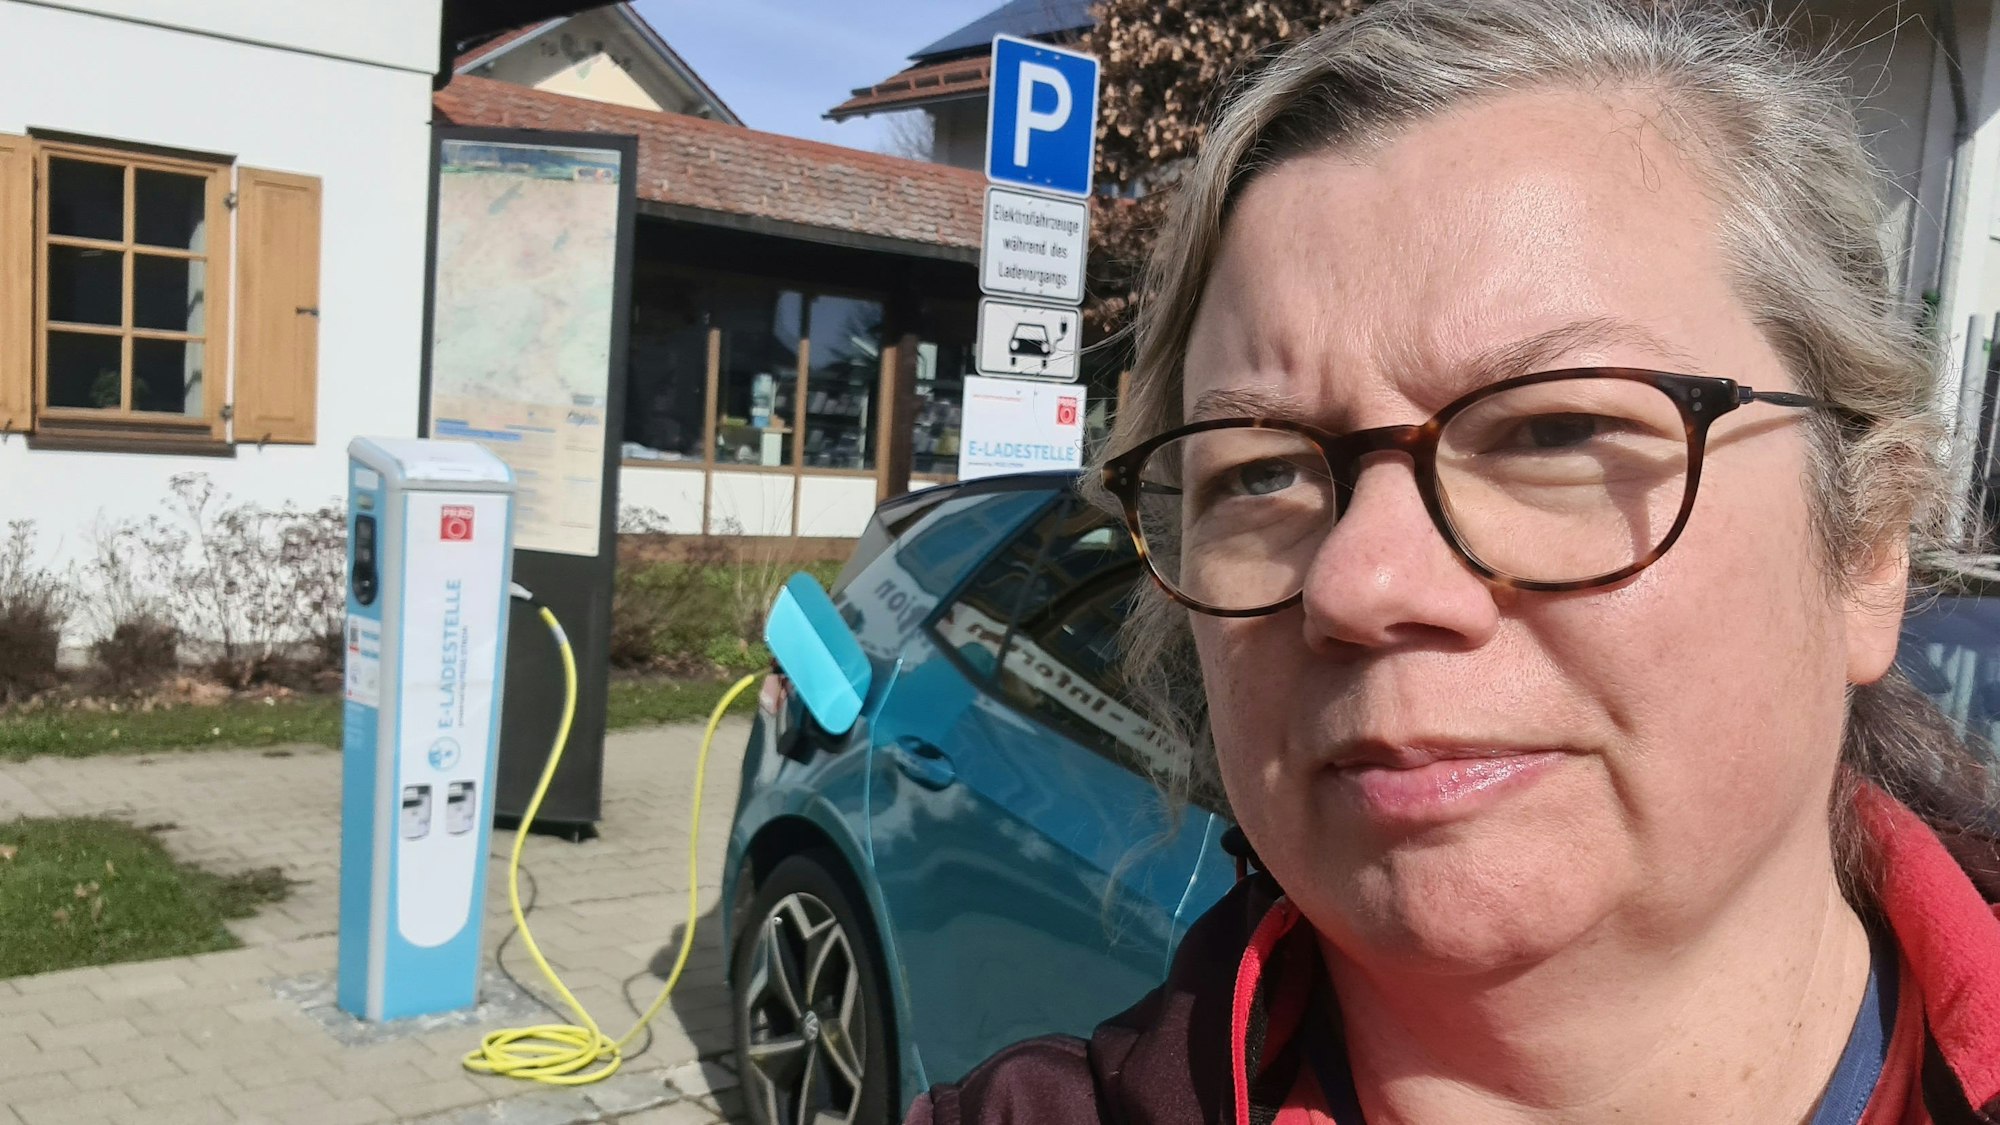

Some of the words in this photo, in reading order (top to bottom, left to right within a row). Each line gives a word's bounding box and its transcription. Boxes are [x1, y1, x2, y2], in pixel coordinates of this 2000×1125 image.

[1013, 60, 1073, 168] P
[992, 203, 1080, 237] Elektrofahrzeuge
[1002, 235, 1047, 255] während
[1050, 241, 1069, 259] des
[998, 261, 1068, 290] Ladevorgangs
[967, 440, 1077, 462] E-LADESTELLE
[437, 578, 463, 730] E-LADESTELLE
